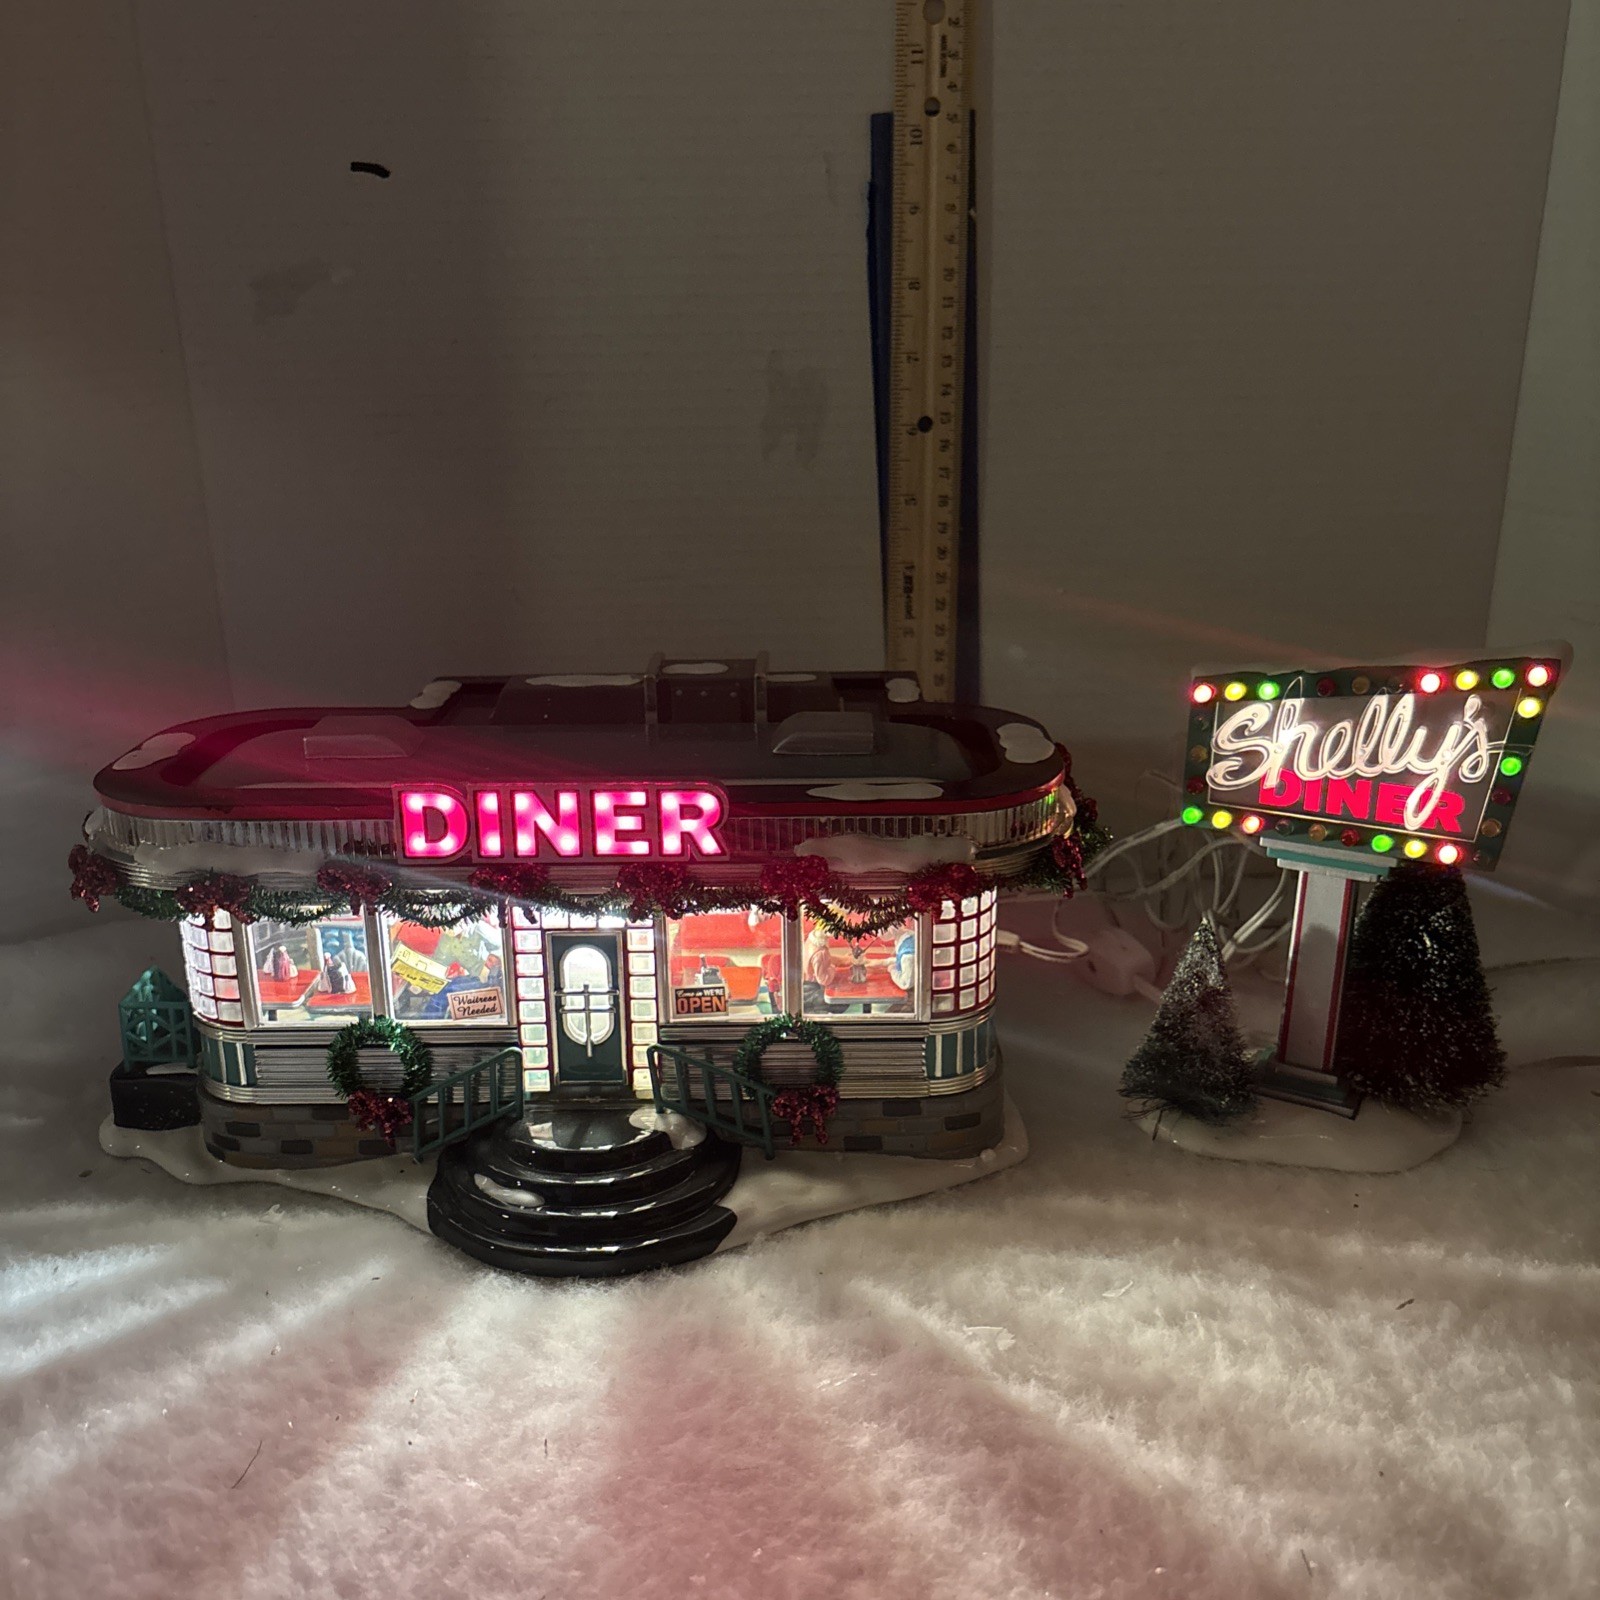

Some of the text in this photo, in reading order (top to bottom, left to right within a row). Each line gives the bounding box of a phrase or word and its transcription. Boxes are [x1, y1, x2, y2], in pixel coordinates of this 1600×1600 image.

[911, 49, 924, 64] 11
[909, 128, 923, 146] 10
[909, 206, 920, 215] 9
[908, 281, 921, 291] 8
[934, 17, 960, 687] 2 3 4 5 6 7 8 9 10 11 12 13 14 15 16 17 18 19 20 21 22 23 24 25
[907, 355, 920, 363] 7
[906, 427, 918, 436] 6
[904, 497, 918, 507] 5
[1206, 682, 1489, 830] Shelly's
[1259, 768, 1465, 832] DINER
[401, 791, 724, 858] DINER
[703, 988, 724, 997] WE'RE
[454, 995, 497, 1006] Waitress
[677, 996, 726, 1013] OPEN
[457, 1003, 497, 1016] Needed
